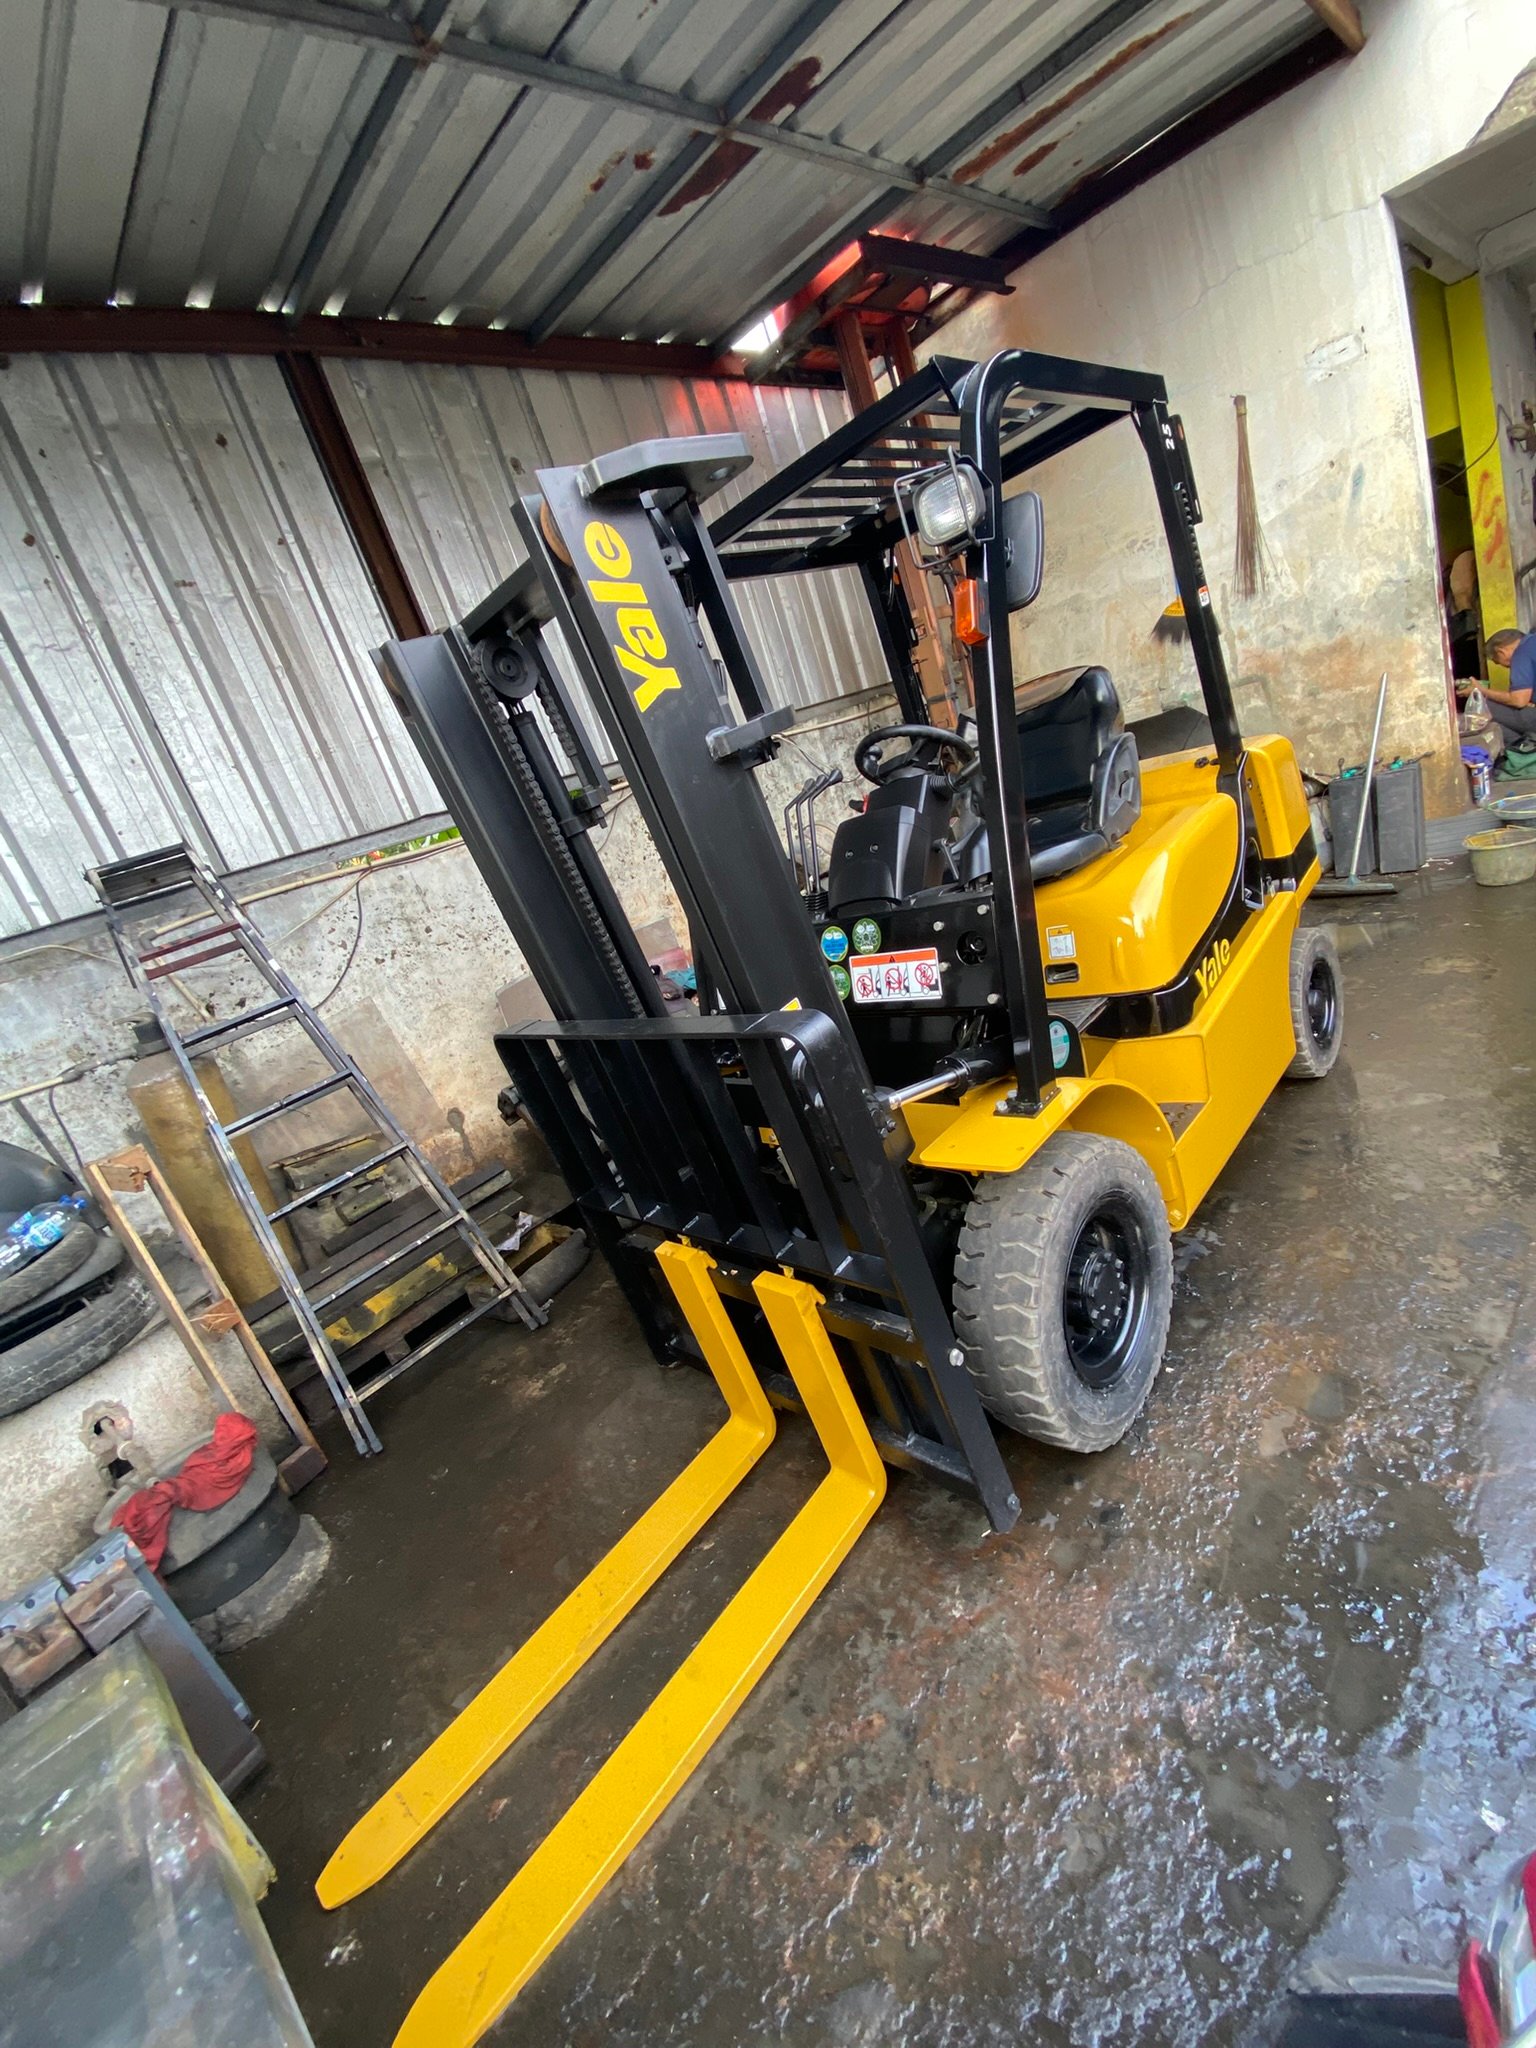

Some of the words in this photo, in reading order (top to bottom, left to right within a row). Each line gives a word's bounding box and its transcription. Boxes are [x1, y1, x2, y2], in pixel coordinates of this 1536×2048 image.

[1161, 423, 1175, 450] 25
[584, 521, 682, 713] Yale
[1194, 938, 1231, 999] Yale
